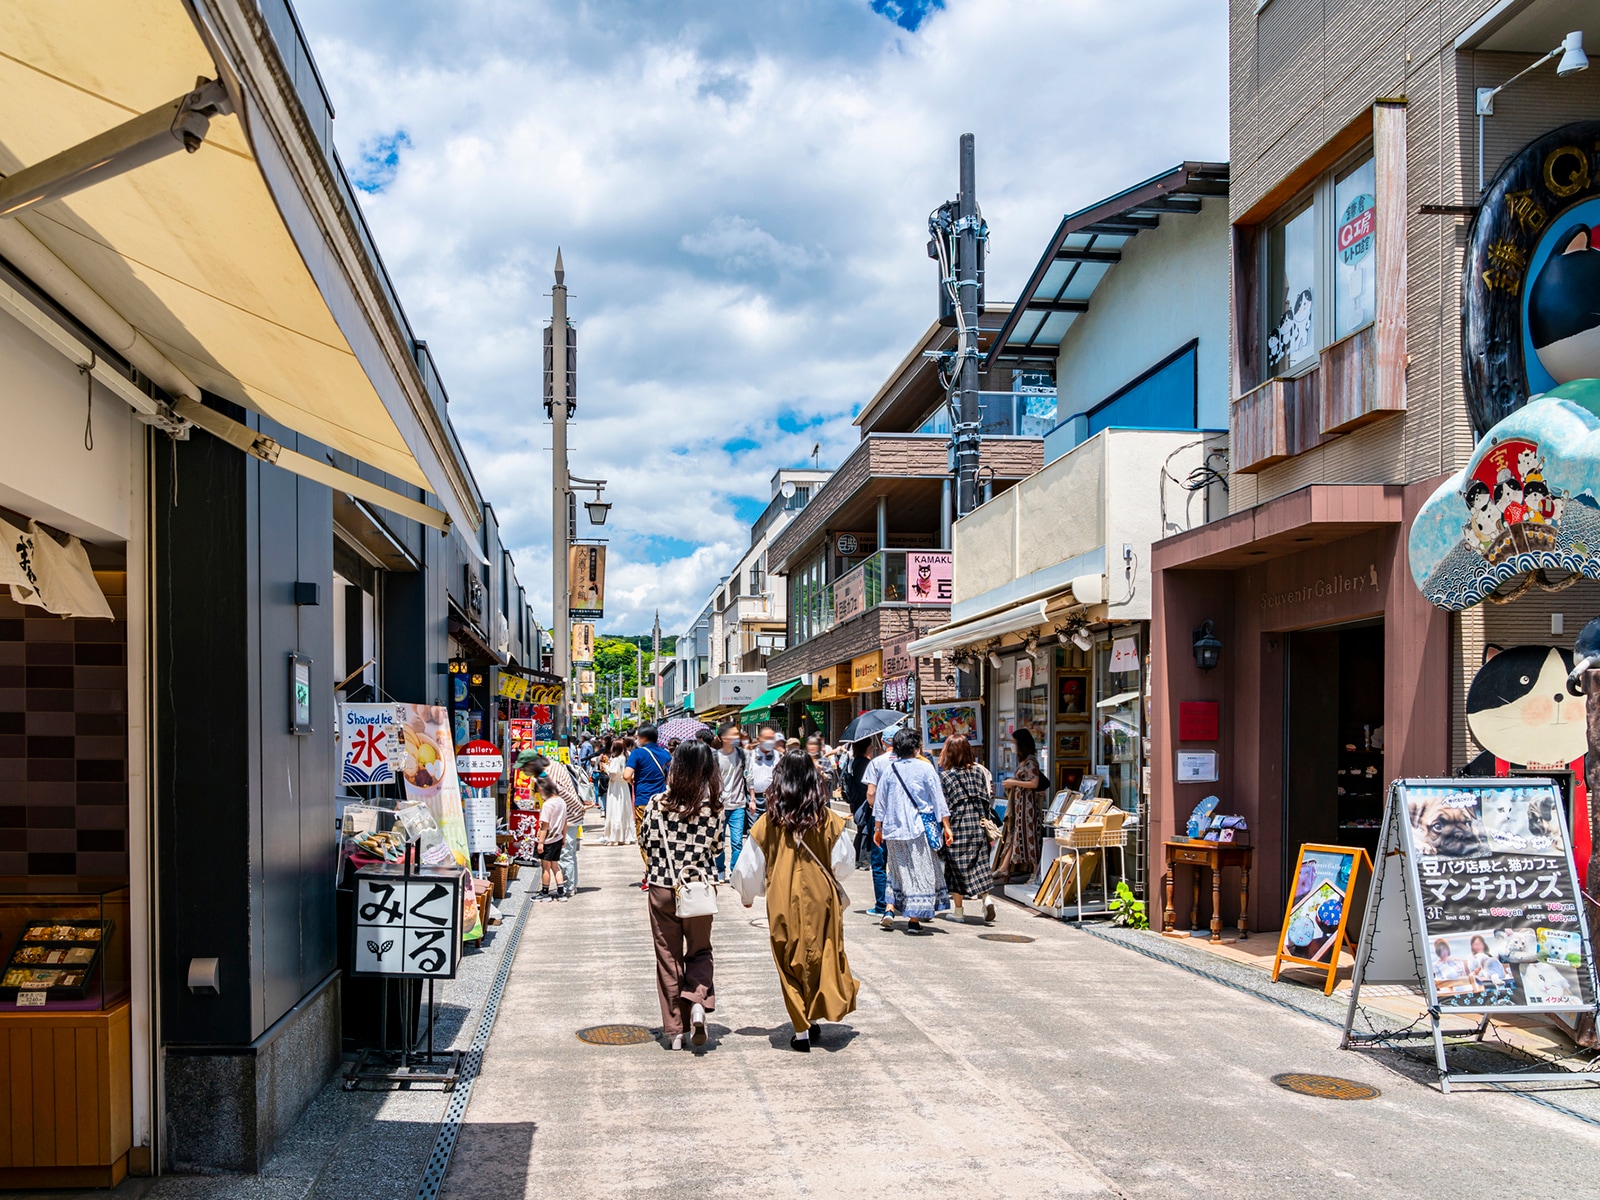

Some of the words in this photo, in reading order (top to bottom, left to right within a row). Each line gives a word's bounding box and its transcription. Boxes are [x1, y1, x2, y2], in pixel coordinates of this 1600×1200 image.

[1345, 195, 1366, 221] 鎌倉
[1341, 211, 1370, 247] Q工房
[1489, 448, 1510, 472] 宝
[1260, 586, 1312, 609] Souvenir
[1314, 575, 1367, 598] Gallery
[347, 712, 380, 725] Shaved
[381, 713, 393, 724] Ice
[351, 724, 388, 768] 氷
[466, 746, 494, 755] gallery
[1425, 871, 1564, 902] マンチカンズ
[1426, 906, 1443, 920] 3F
[1490, 907, 1524, 917] 800yen
[1547, 902, 1576, 912] 700yen
[1548, 914, 1578, 923] 600yen
